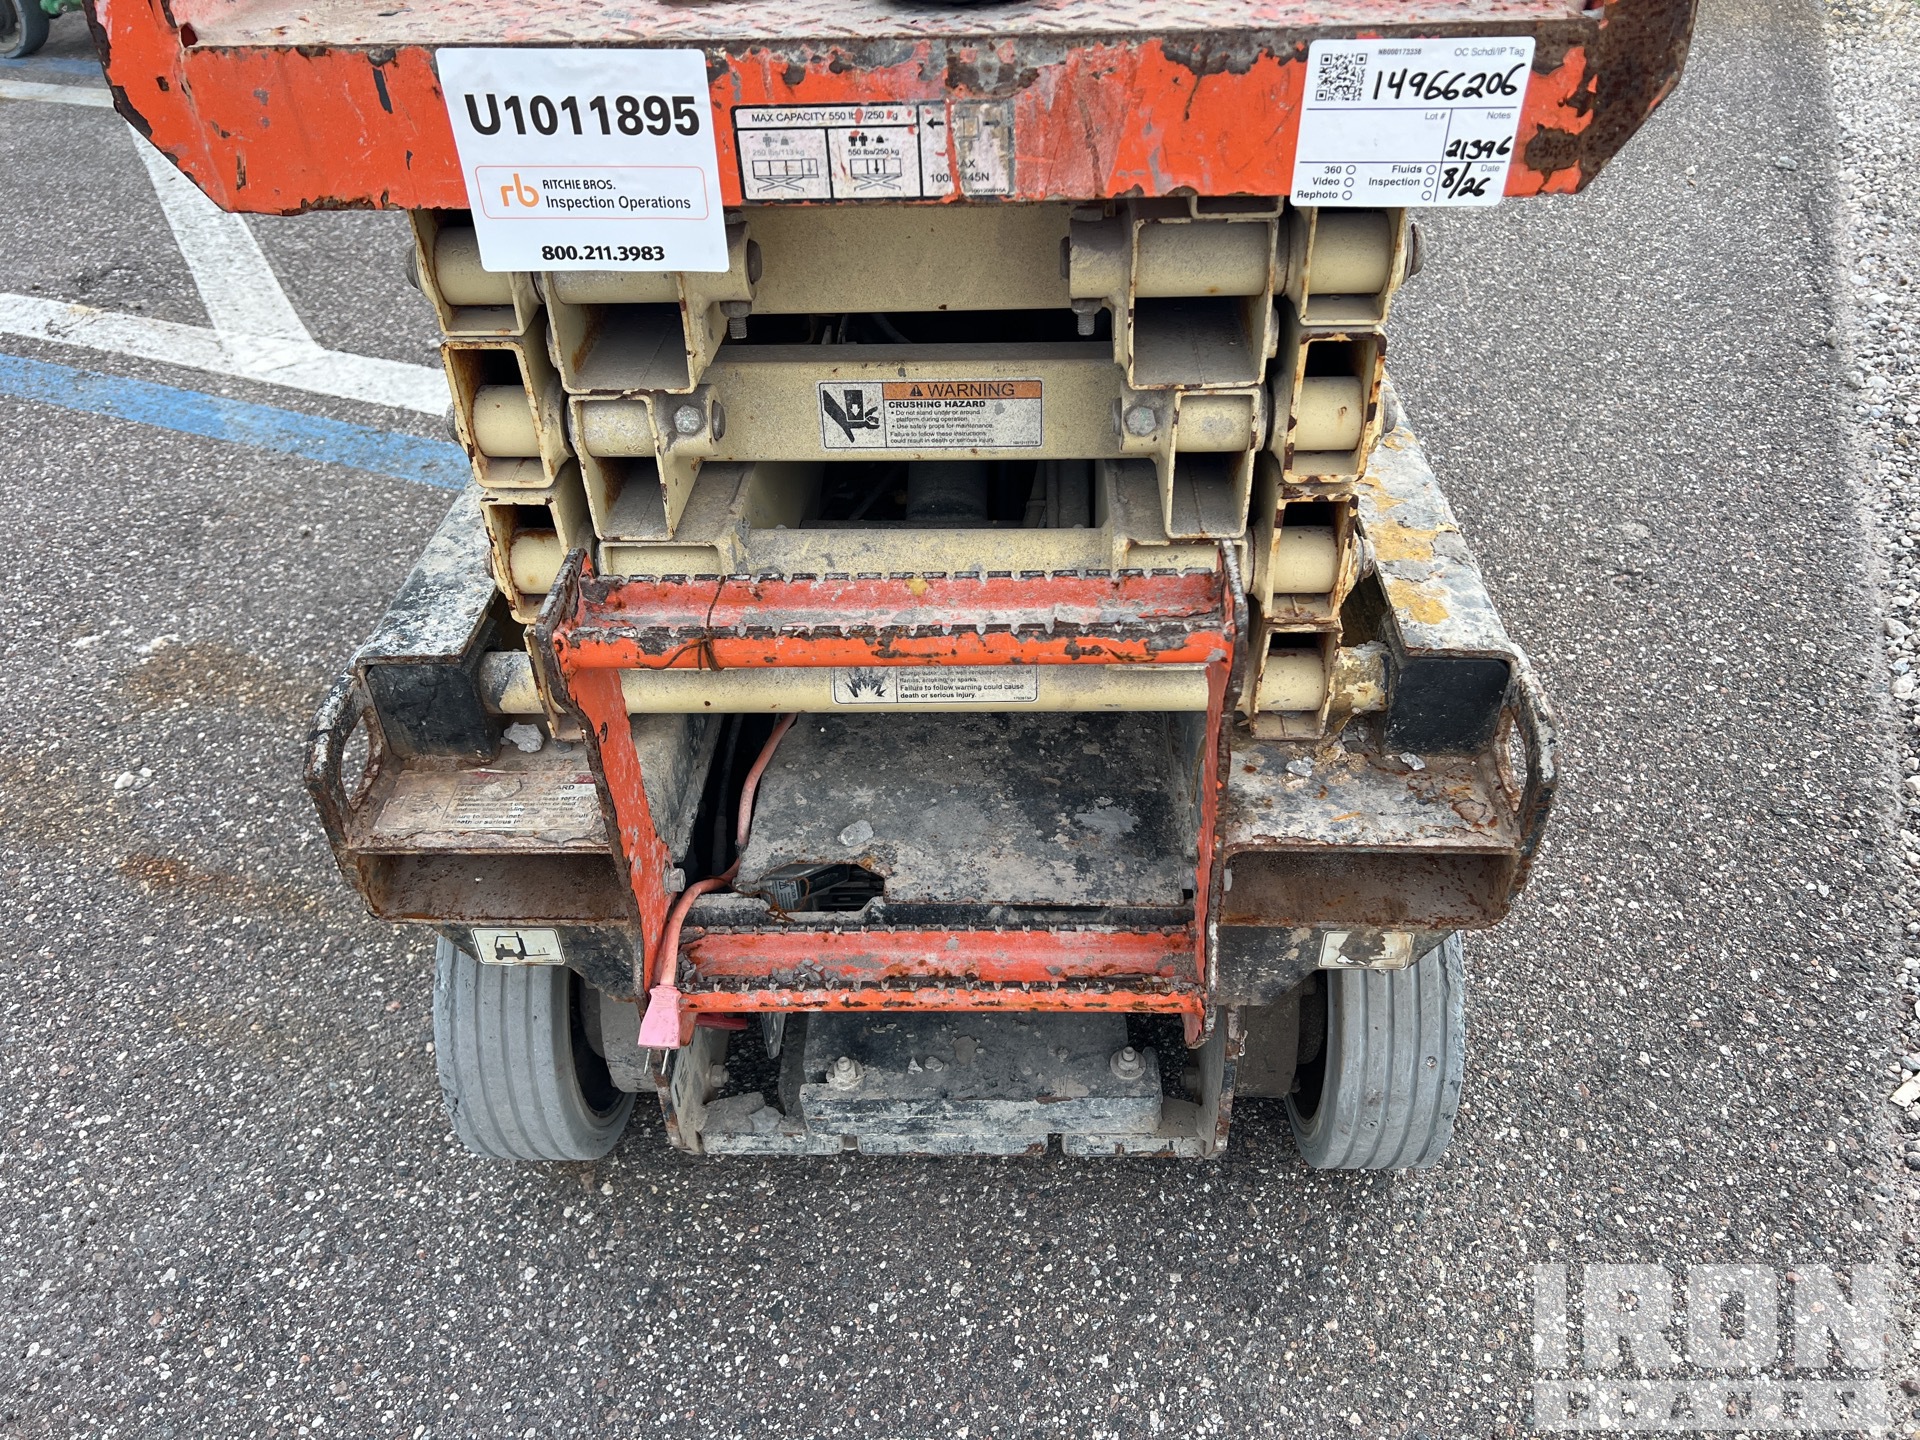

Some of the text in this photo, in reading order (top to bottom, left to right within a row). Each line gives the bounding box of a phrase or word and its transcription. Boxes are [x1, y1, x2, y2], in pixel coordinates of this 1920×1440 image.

[1454, 47, 1469, 57] OC
[1508, 46, 1526, 57] Tag
[1372, 62, 1526, 100] 14966206
[464, 93, 700, 136] U1011895
[751, 113, 773, 122] MAX
[775, 112, 826, 121] CAPACITY
[829, 111, 846, 120] 550
[1424, 112, 1437, 121] Lot
[1486, 111, 1511, 120] Notes
[888, 149, 900, 157] kg
[1324, 166, 1342, 174] 360
[1391, 165, 1422, 174] Fluids
[1480, 164, 1500, 173] Date
[542, 178, 616, 190] RITCHIE BROS.
[1312, 178, 1340, 186] Video
[1368, 177, 1420, 188] Inspection
[1441, 162, 1491, 199] 8/26
[500, 173, 540, 208] rb
[1297, 190, 1338, 200] Rephoto
[546, 195, 691, 212] Inspection Operations
[542, 245, 665, 261] 800.211.3983
[928, 383, 1015, 397] WARNING
[944, 400, 985, 408] HAZARD
